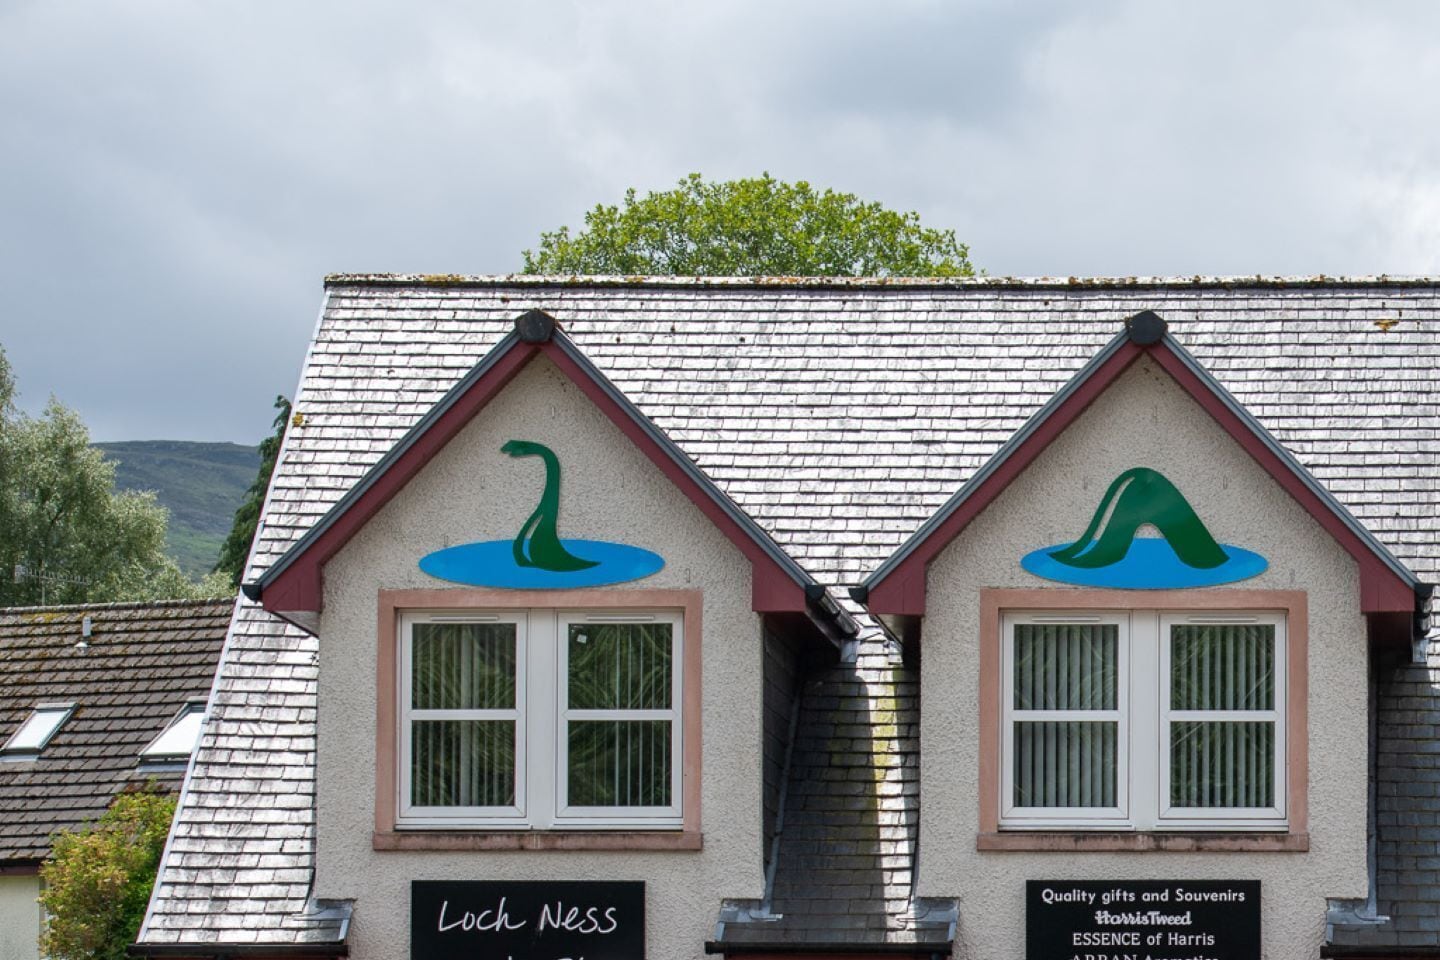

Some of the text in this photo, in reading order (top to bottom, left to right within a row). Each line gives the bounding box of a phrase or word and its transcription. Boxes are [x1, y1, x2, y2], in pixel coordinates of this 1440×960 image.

[1041, 888, 1245, 904] Quality gifts and Souvenirs
[438, 897, 617, 934] Loch Ness
[1072, 932, 1215, 946] ESSENCE of Harris
